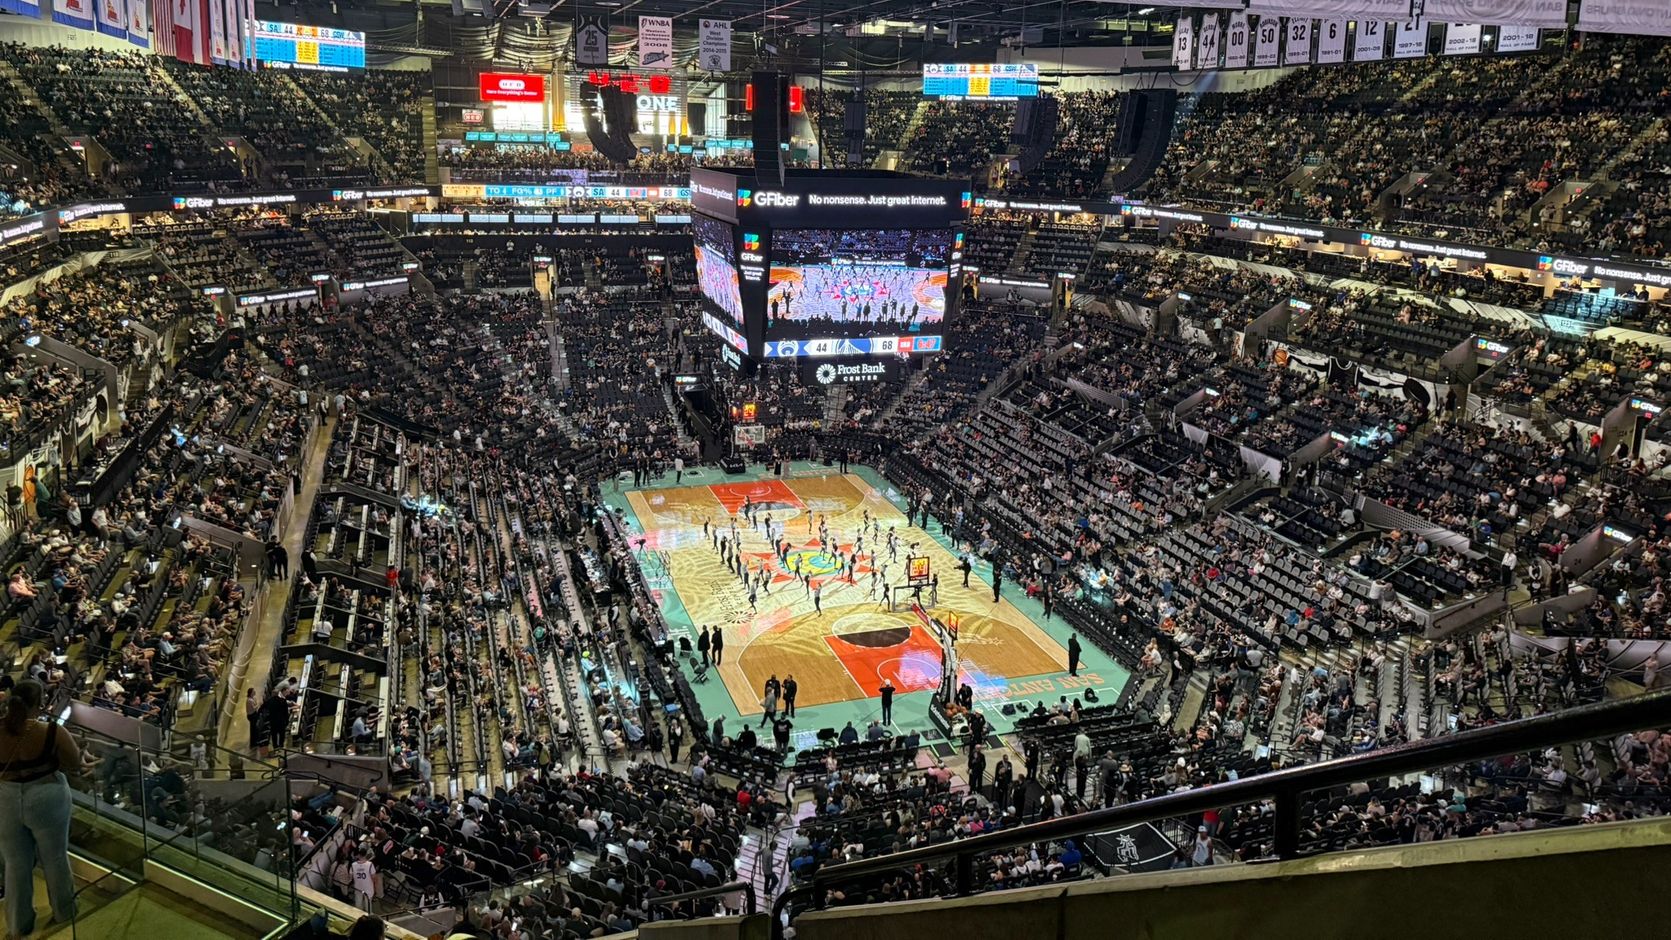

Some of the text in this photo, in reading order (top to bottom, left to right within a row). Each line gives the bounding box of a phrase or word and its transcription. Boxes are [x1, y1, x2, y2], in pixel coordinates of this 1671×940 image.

[270, 24, 278, 32] SA
[285, 26, 293, 34] 44
[321, 29, 329, 38] 68
[1262, 28, 1274, 43] 50
[1292, 25, 1306, 40] 32
[1329, 23, 1336, 39] 6
[1365, 21, 1377, 36] 12
[585, 30, 597, 45] 25
[1179, 37, 1187, 51] 13
[1203, 35, 1214, 48] 44
[1232, 31, 1243, 46] 00
[637, 96, 678, 111] ONE
[342, 190, 363, 199] GFiber
[754, 192, 947, 207] GFiber No nonsense. Just great internet.
[186, 198, 213, 207] GFiber
[985, 200, 1006, 208] GFiber
[1132, 207, 1152, 215] GFiber
[1239, 219, 1258, 229] GFiber
[1371, 235, 1396, 248] GFiber
[741, 253, 763, 261] GFiber
[1553, 260, 1588, 274] GFiber
[1594, 266, 1605, 275] No
[1606, 267, 1642, 280] nonsense.
[1644, 273, 1662, 282] Just
[816, 343, 827, 352] 44
[883, 341, 893, 350] 68
[1487, 342, 1509, 353] GFiber
[838, 362, 885, 374] Frost Bank
[1056, 673, 1105, 689] SAN
